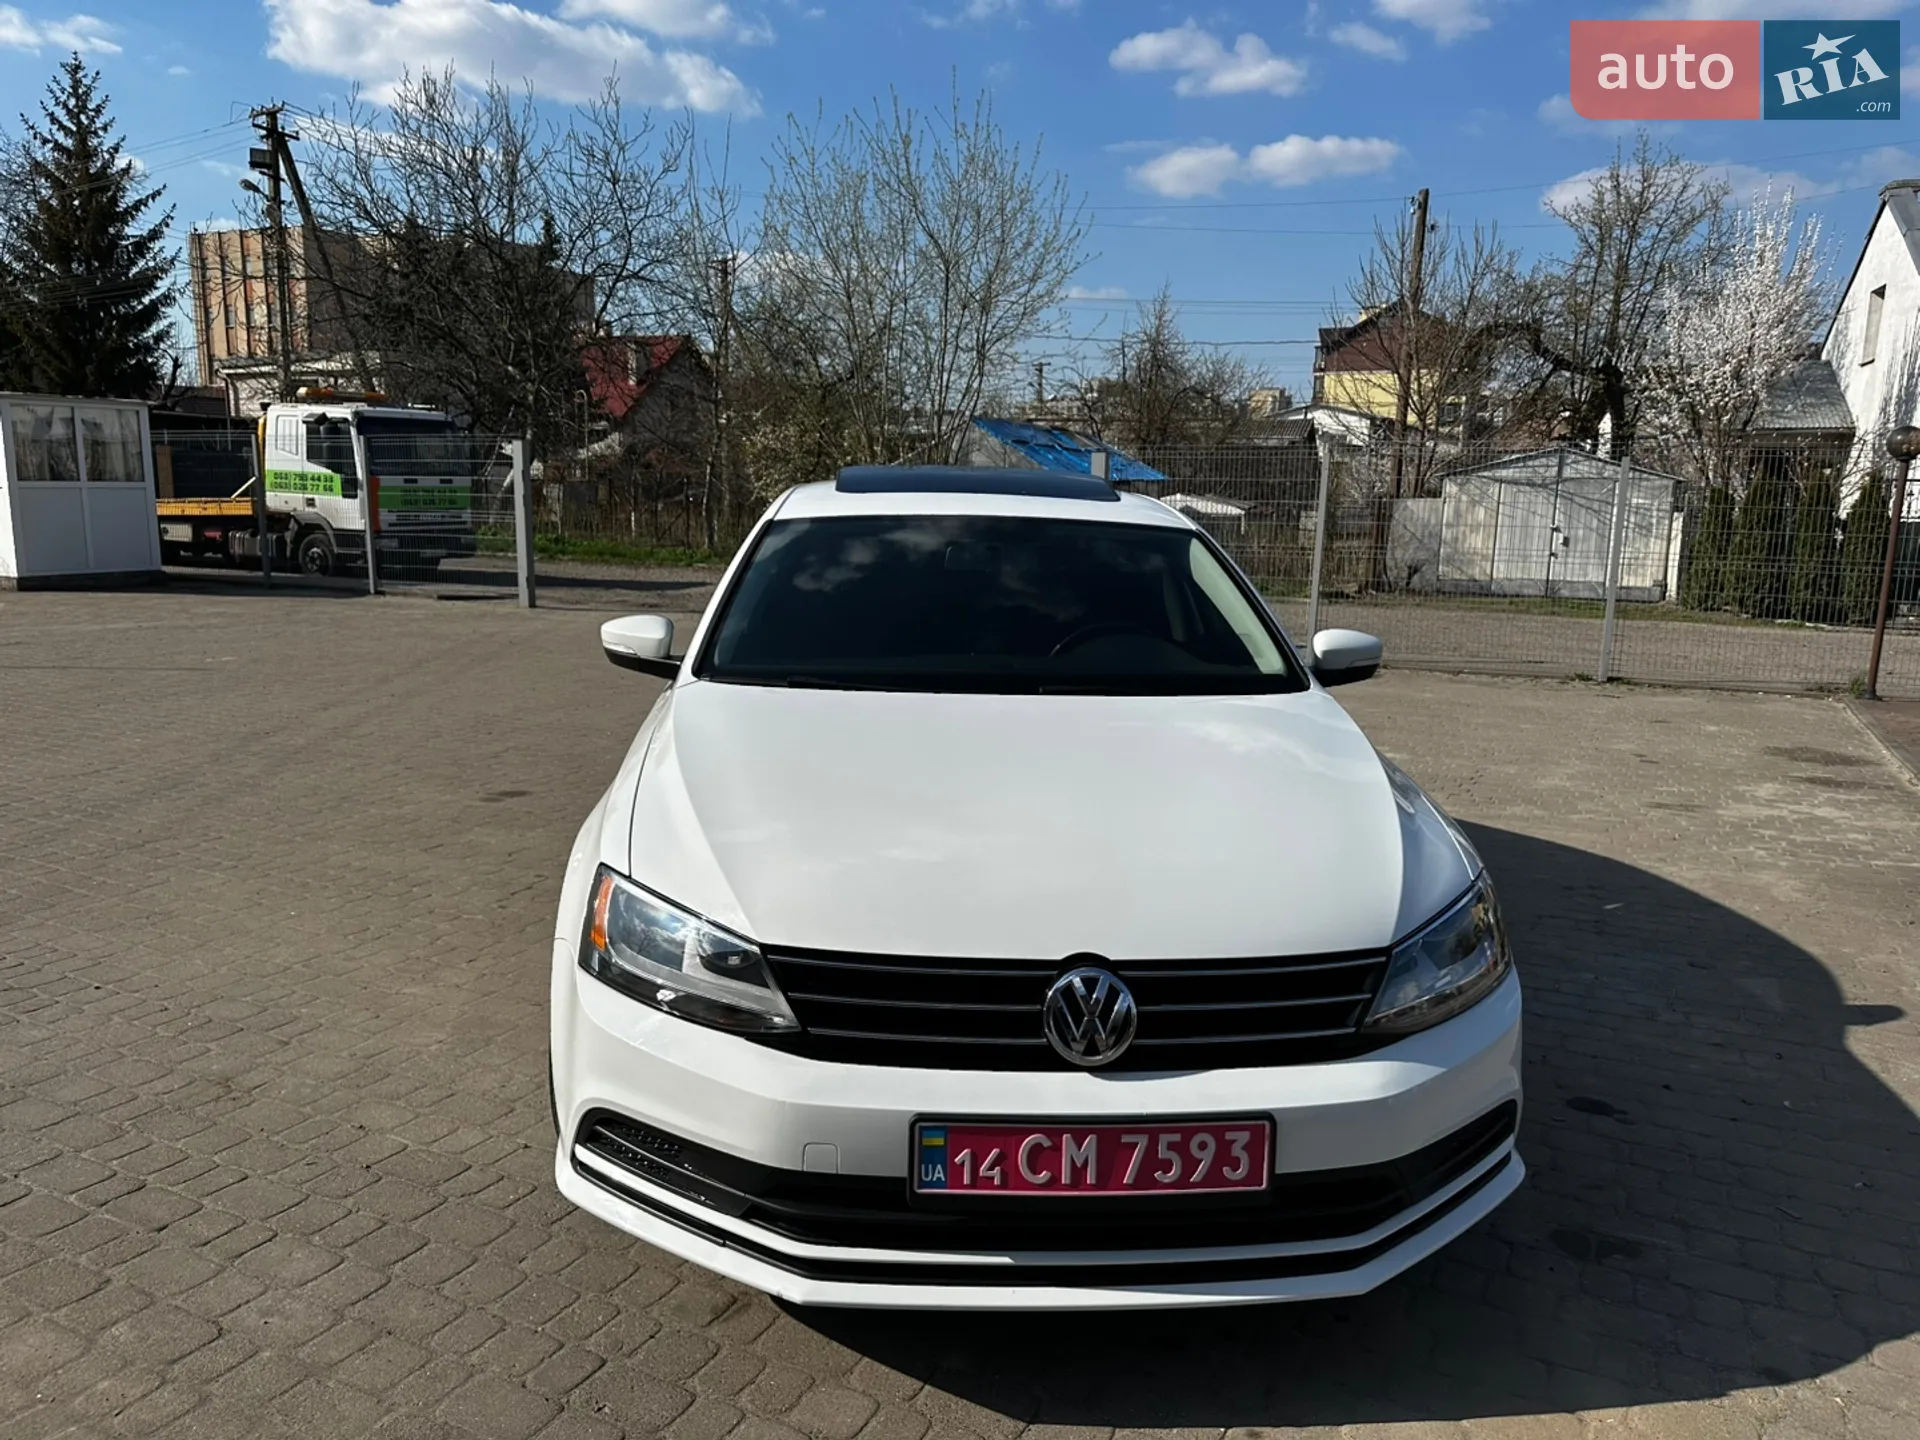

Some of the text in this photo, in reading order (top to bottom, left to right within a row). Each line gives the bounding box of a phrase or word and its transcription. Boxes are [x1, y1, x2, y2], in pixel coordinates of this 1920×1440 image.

[921, 1163, 946, 1183] UA
[954, 1130, 1251, 1186] 14 CM 7593
